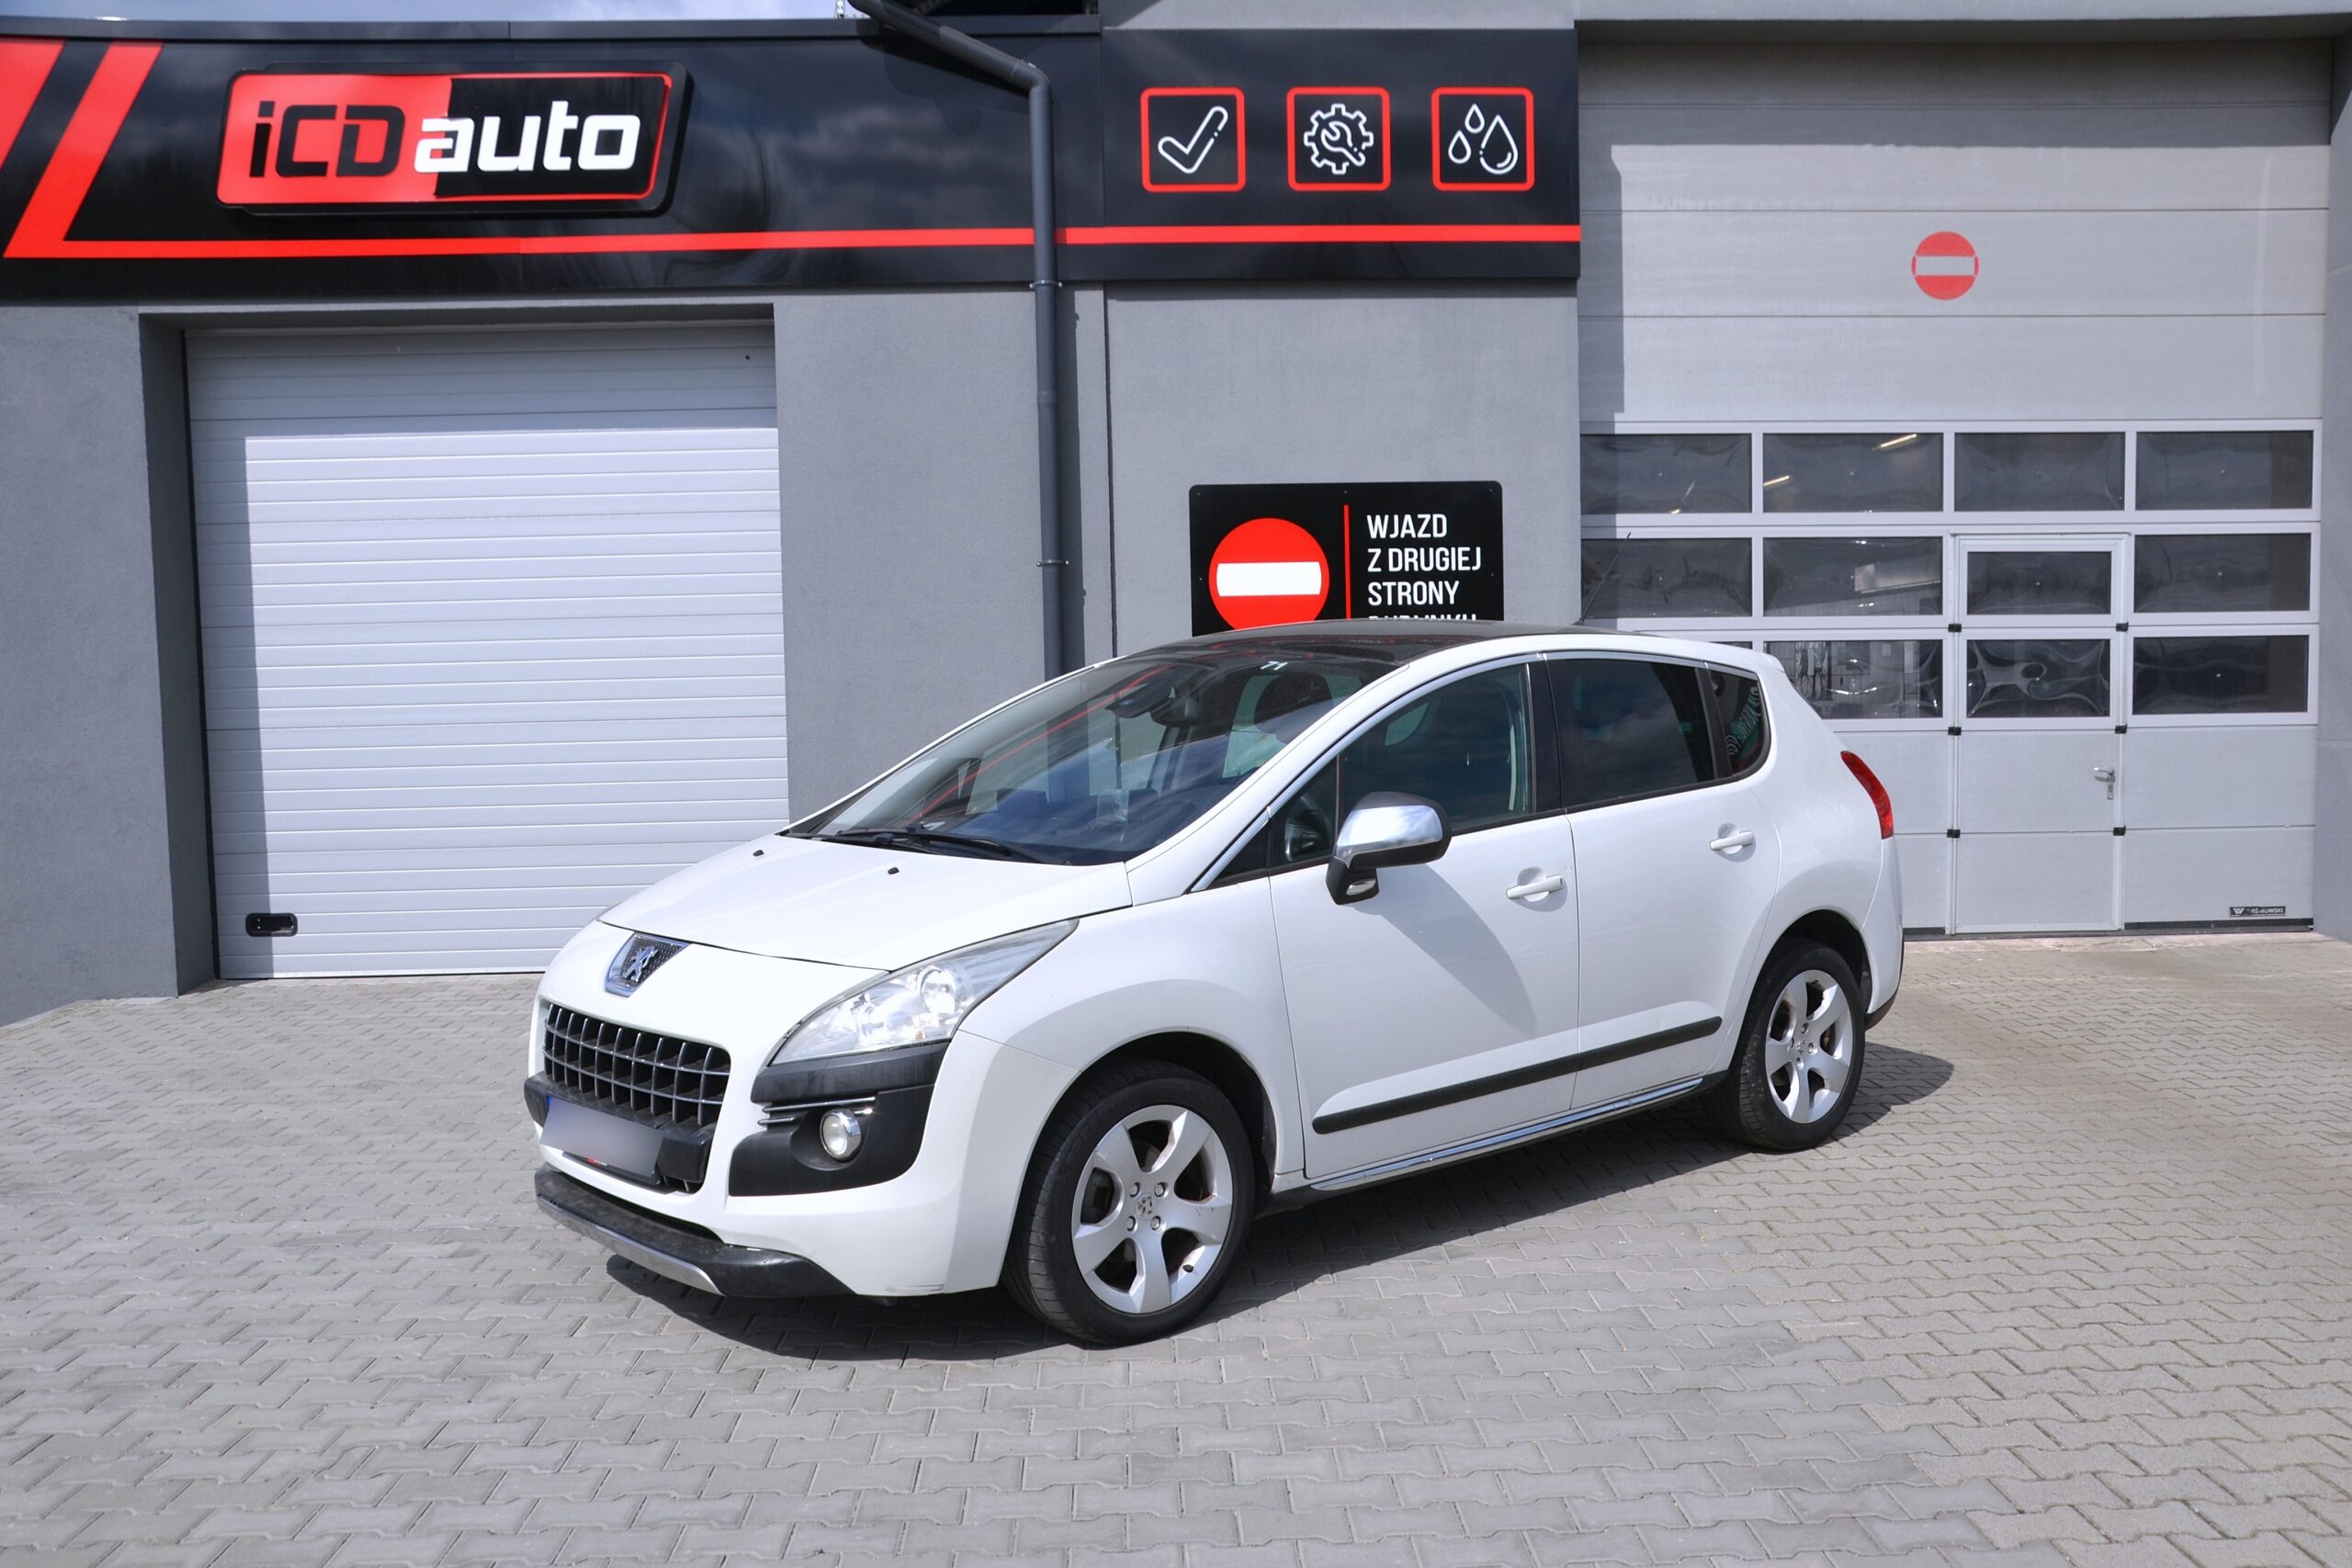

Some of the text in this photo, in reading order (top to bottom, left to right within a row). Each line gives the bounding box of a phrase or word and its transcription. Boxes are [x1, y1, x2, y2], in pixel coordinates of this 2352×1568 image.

[1366, 513, 1448, 539] WJAZD
[1367, 546, 1481, 572] Z DRUGIEJ
[1367, 580, 1460, 606] STRONY
